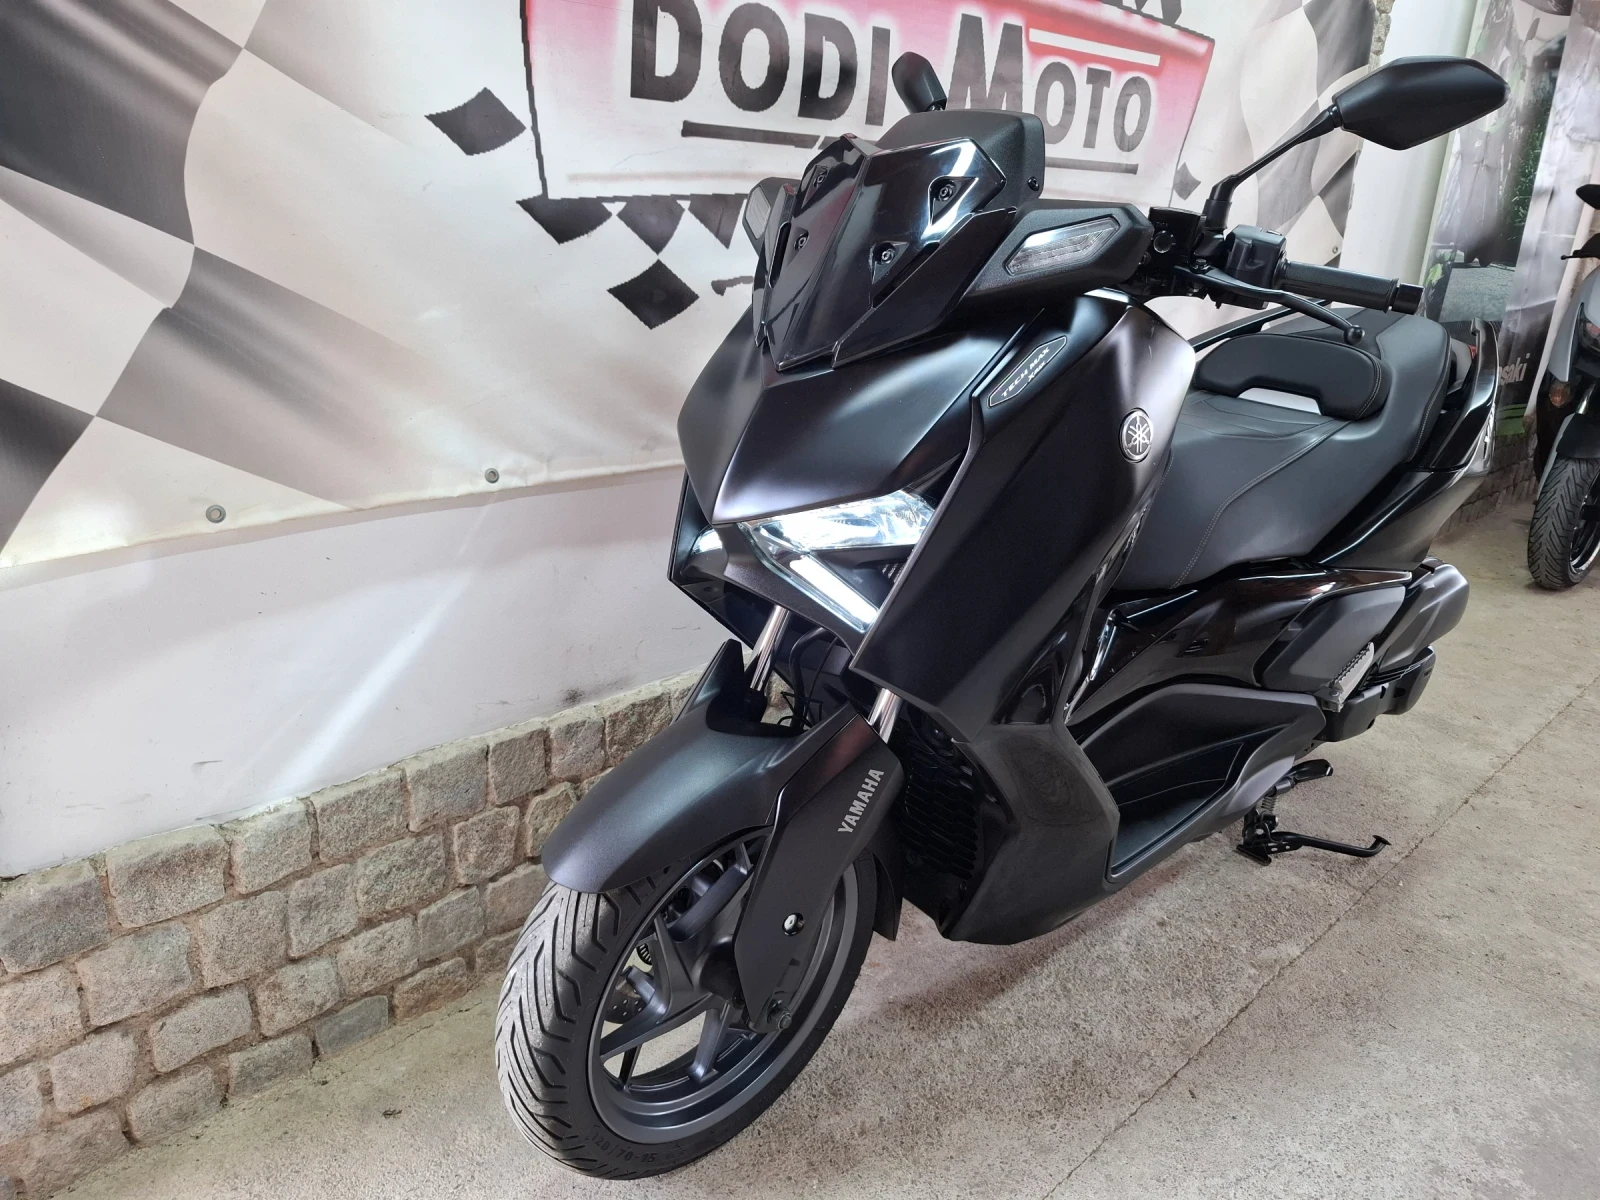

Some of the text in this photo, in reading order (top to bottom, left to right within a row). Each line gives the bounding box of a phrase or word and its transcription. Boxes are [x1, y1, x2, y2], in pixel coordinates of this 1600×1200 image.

[630, 0, 891, 126] DODI
[1001, 346, 1050, 397] TECH MAX
[837, 768, 885, 833] YAMAHA
